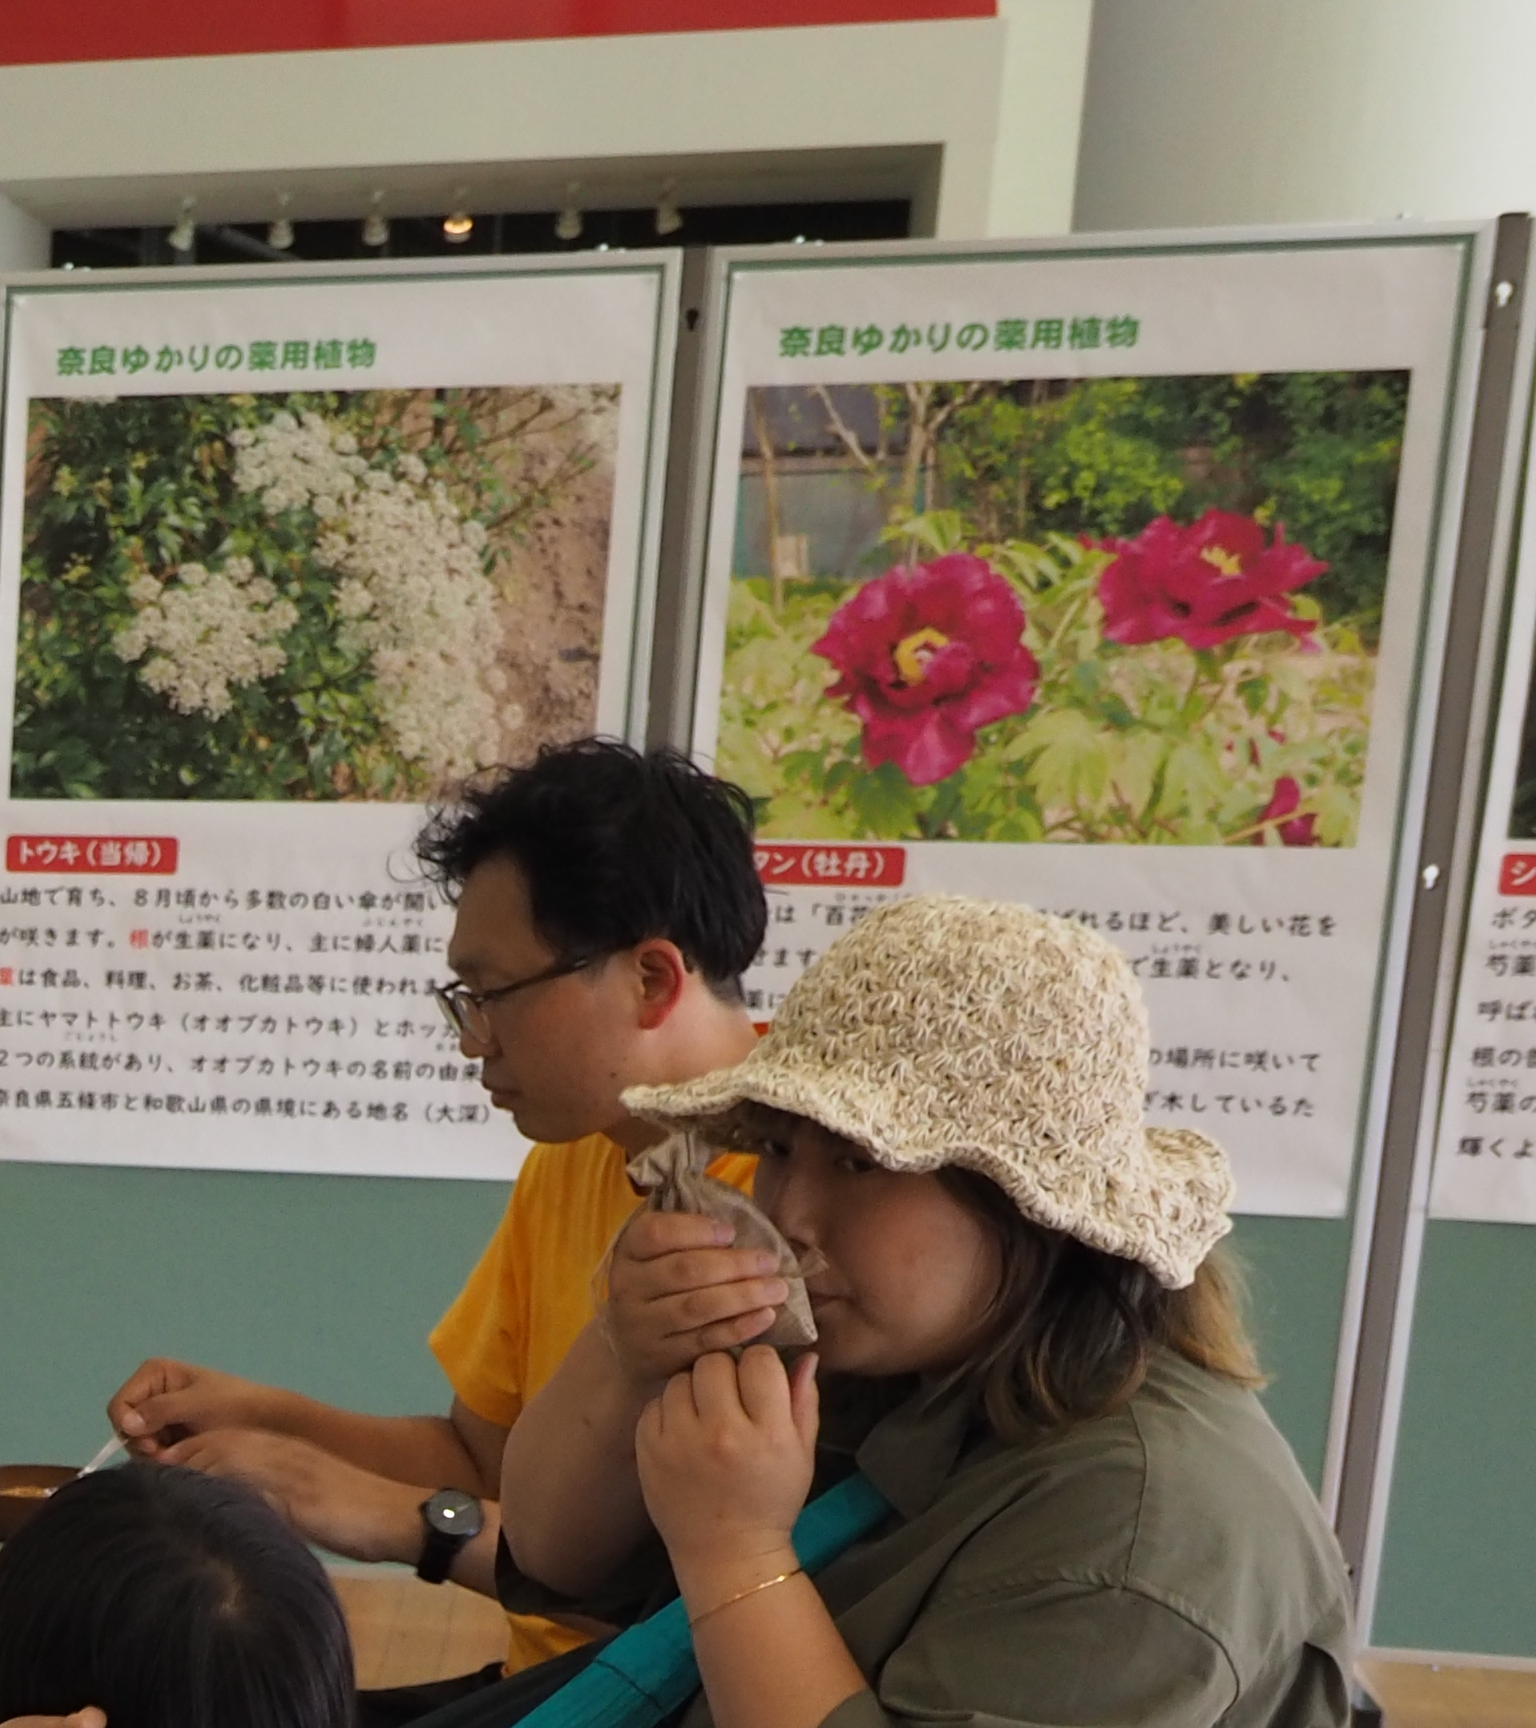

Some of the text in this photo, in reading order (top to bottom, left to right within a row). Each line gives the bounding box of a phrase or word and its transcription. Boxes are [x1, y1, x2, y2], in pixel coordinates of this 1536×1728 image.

[779, 313, 1141, 358] 奈良ゆかりの薬用植物
[56, 337, 378, 378] 奈良ゆかりの薬用植物
[17, 840, 166, 870] トウキ（当帰）
